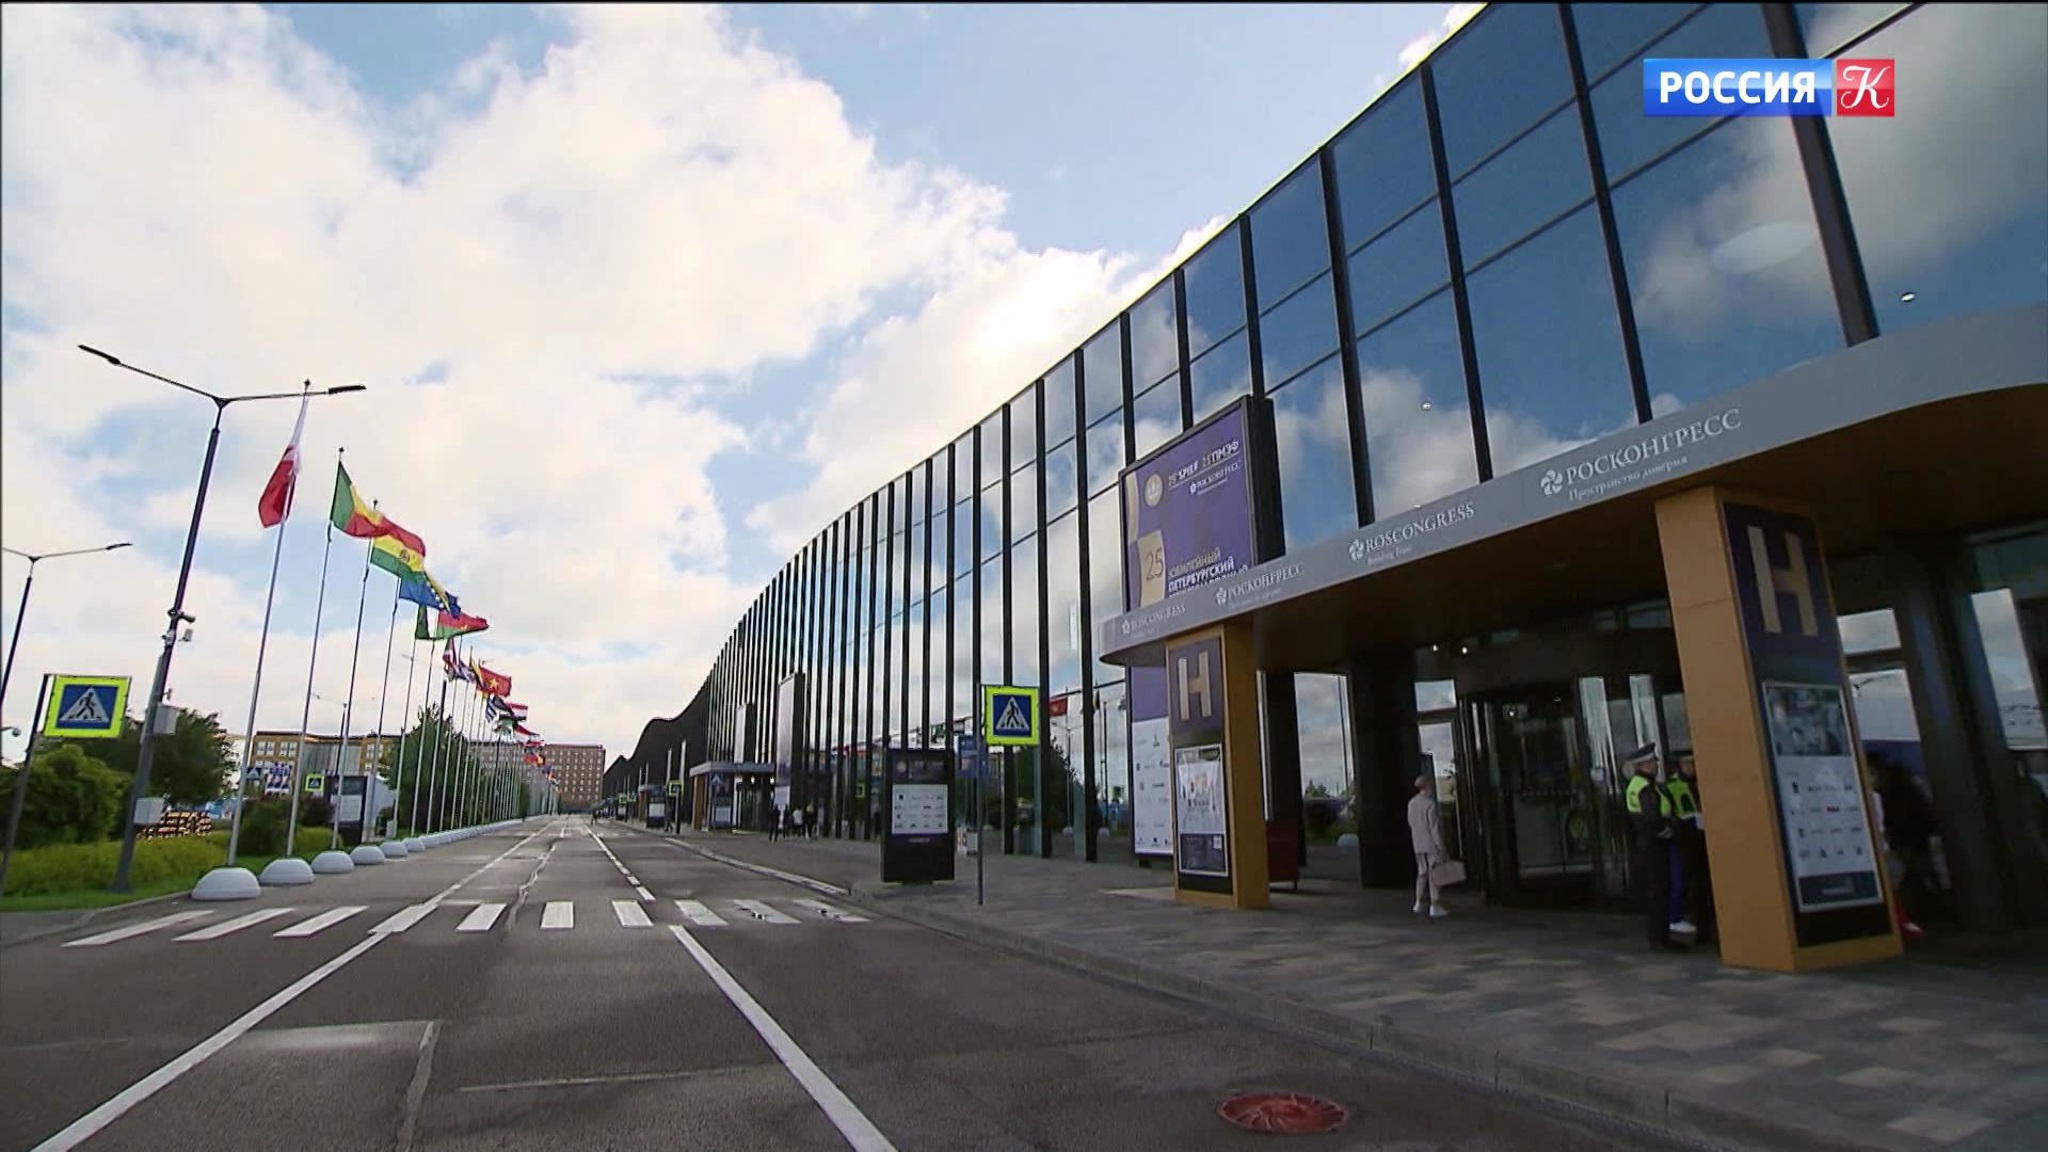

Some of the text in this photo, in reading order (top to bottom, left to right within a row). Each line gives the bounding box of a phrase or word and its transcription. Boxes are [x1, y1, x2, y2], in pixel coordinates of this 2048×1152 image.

[1566, 408, 1741, 485] РОСКОНГРЕСС
[1569, 471, 1640, 501] Пространство
[1365, 500, 1475, 553] ROSCONGRESS
[1144, 547, 1163, 582] 25
[1227, 561, 1305, 598] РОСКОНГРЕСС
